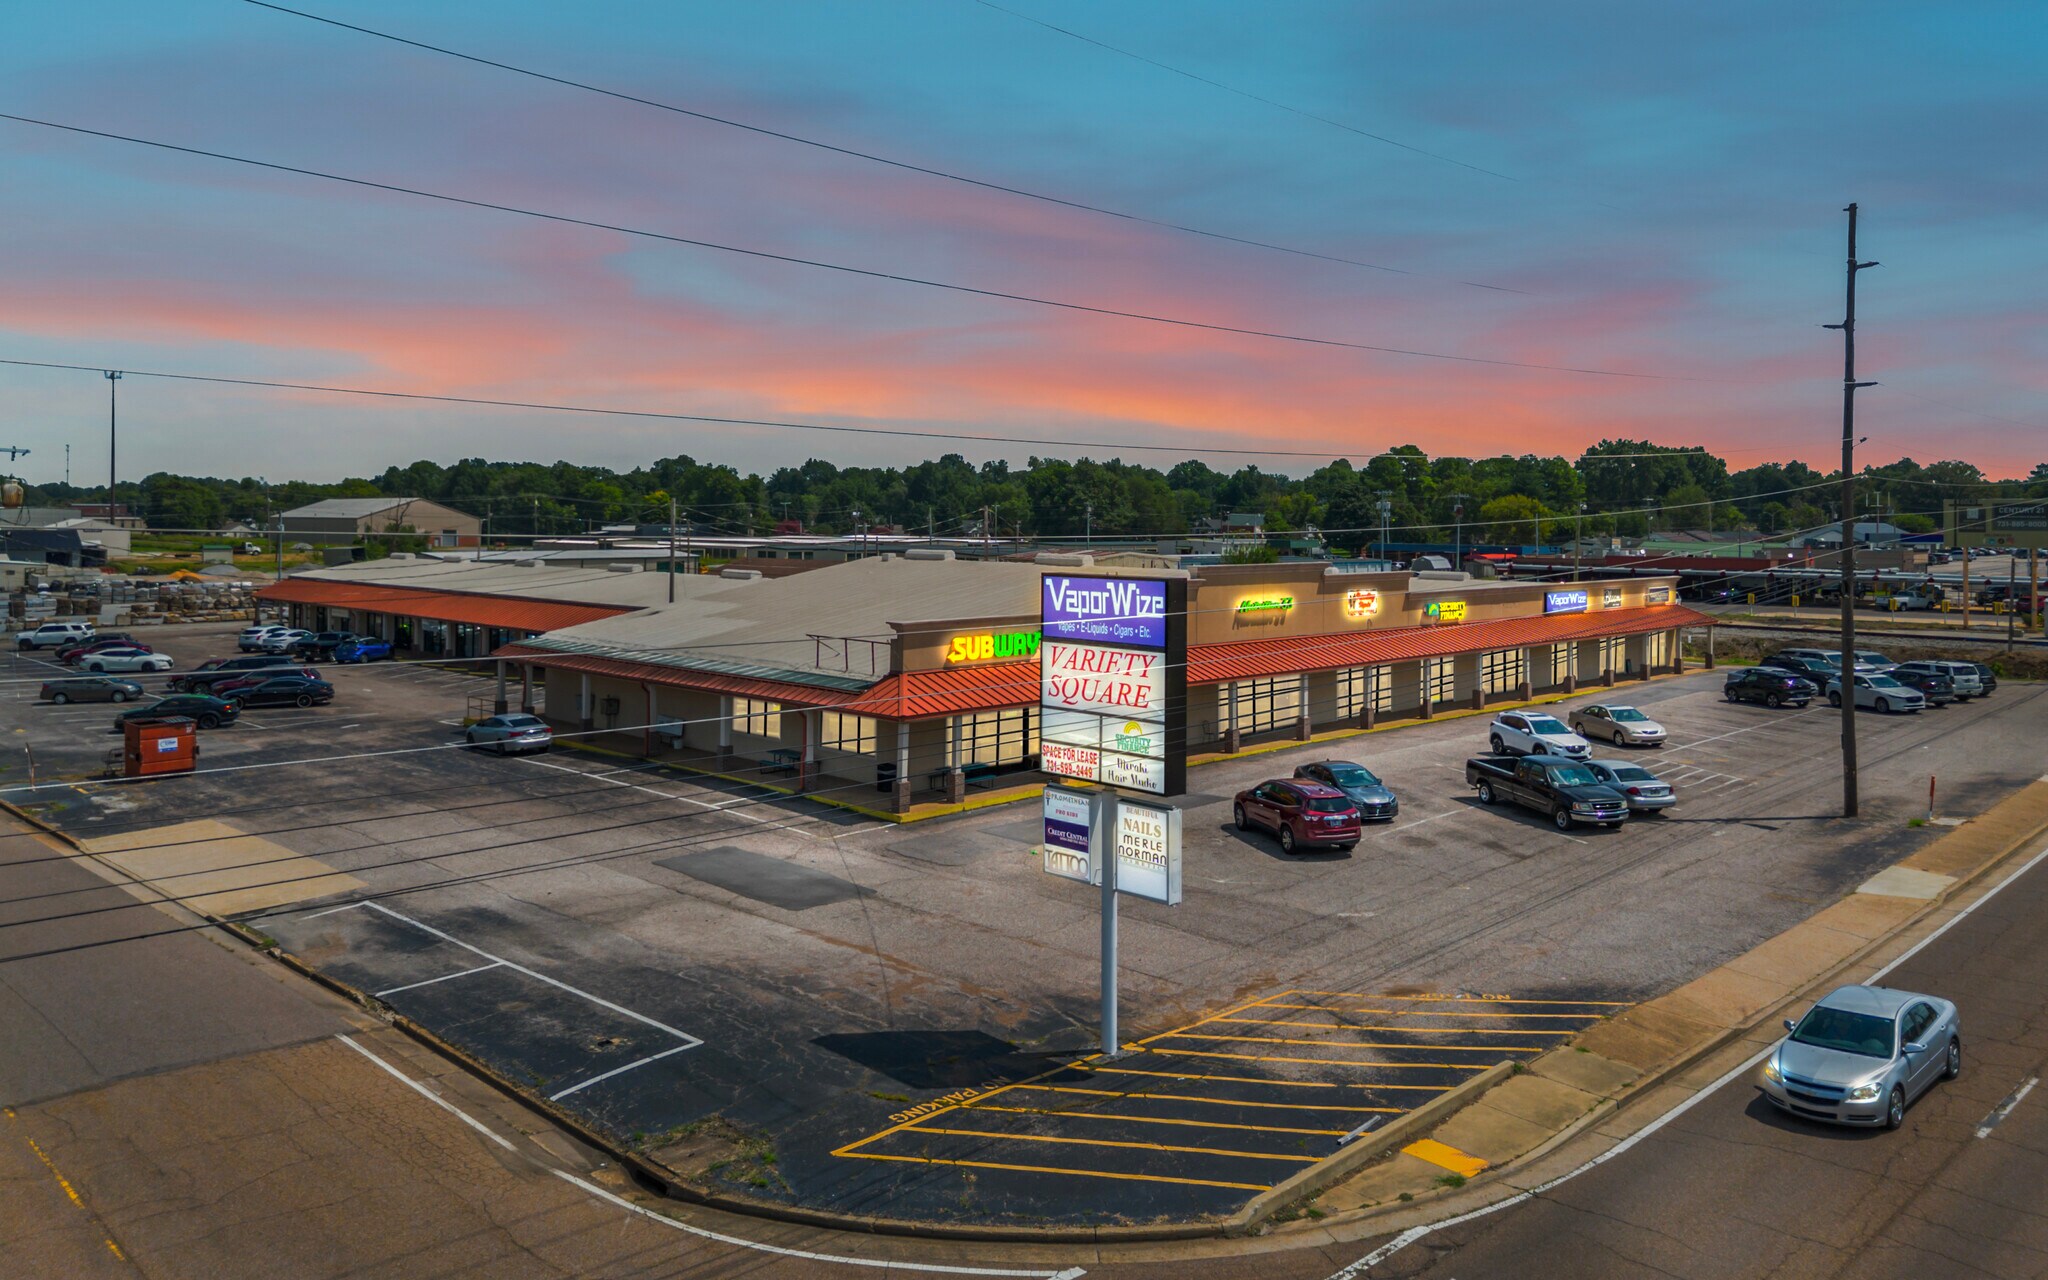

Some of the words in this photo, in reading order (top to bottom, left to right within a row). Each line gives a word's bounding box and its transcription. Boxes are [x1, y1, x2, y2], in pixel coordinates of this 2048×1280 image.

[1046, 578, 1164, 618] VaporWize
[1058, 621, 1075, 633] Vapes
[1081, 621, 1108, 636] E-Liquids
[1114, 624, 1133, 638] Cigars
[1140, 626, 1151, 638] Etc.
[948, 630, 1041, 664] SUBWAY
[1051, 645, 1157, 678] VARIETY
[1048, 674, 1151, 708] SQUARE
[1115, 733, 1151, 747] SECURITY
[1117, 741, 1149, 754] FINANCE
[1042, 744, 1061, 759] SPACE
[1063, 749, 1075, 761] FOR
[1077, 750, 1098, 765] LEASE
[1046, 759, 1093, 778] 731-599-2449
[1108, 769, 1127, 782] Hair
[1131, 774, 1156, 789] Studio
[1051, 793, 1089, 806] PROMETHEAN
[1126, 806, 1158, 819] BEAUTIFUL
[1048, 827, 1066, 838] CREDIT
[1066, 831, 1088, 843] CENTRAL
[1123, 817, 1161, 838] NAILS
[1123, 834, 1162, 852] MERLE
[1045, 849, 1089, 877] TATTOO
[1118, 845, 1167, 866] NORMAN
[981, 1075, 1012, 1090] NO
[888, 1087, 979, 1123] PARKING
